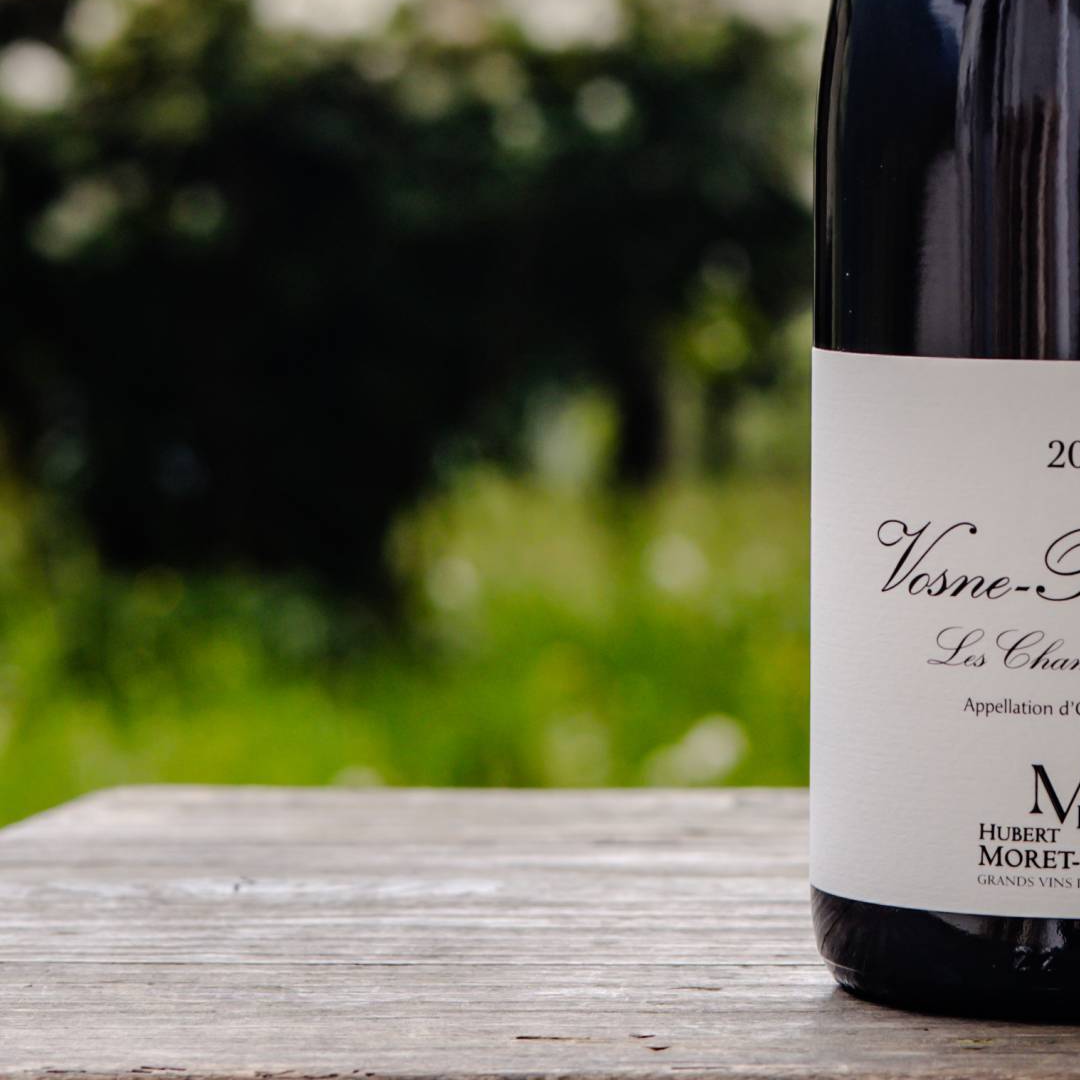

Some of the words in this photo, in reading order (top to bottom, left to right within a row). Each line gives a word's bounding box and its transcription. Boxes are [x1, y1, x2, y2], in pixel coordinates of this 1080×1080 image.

[926, 625, 986, 668] Les
[963, 696, 1054, 718] Appellation
[978, 822, 1062, 844] HUBERT
[976, 874, 1035, 887] GRANDS
[1038, 876, 1073, 889] VINS
